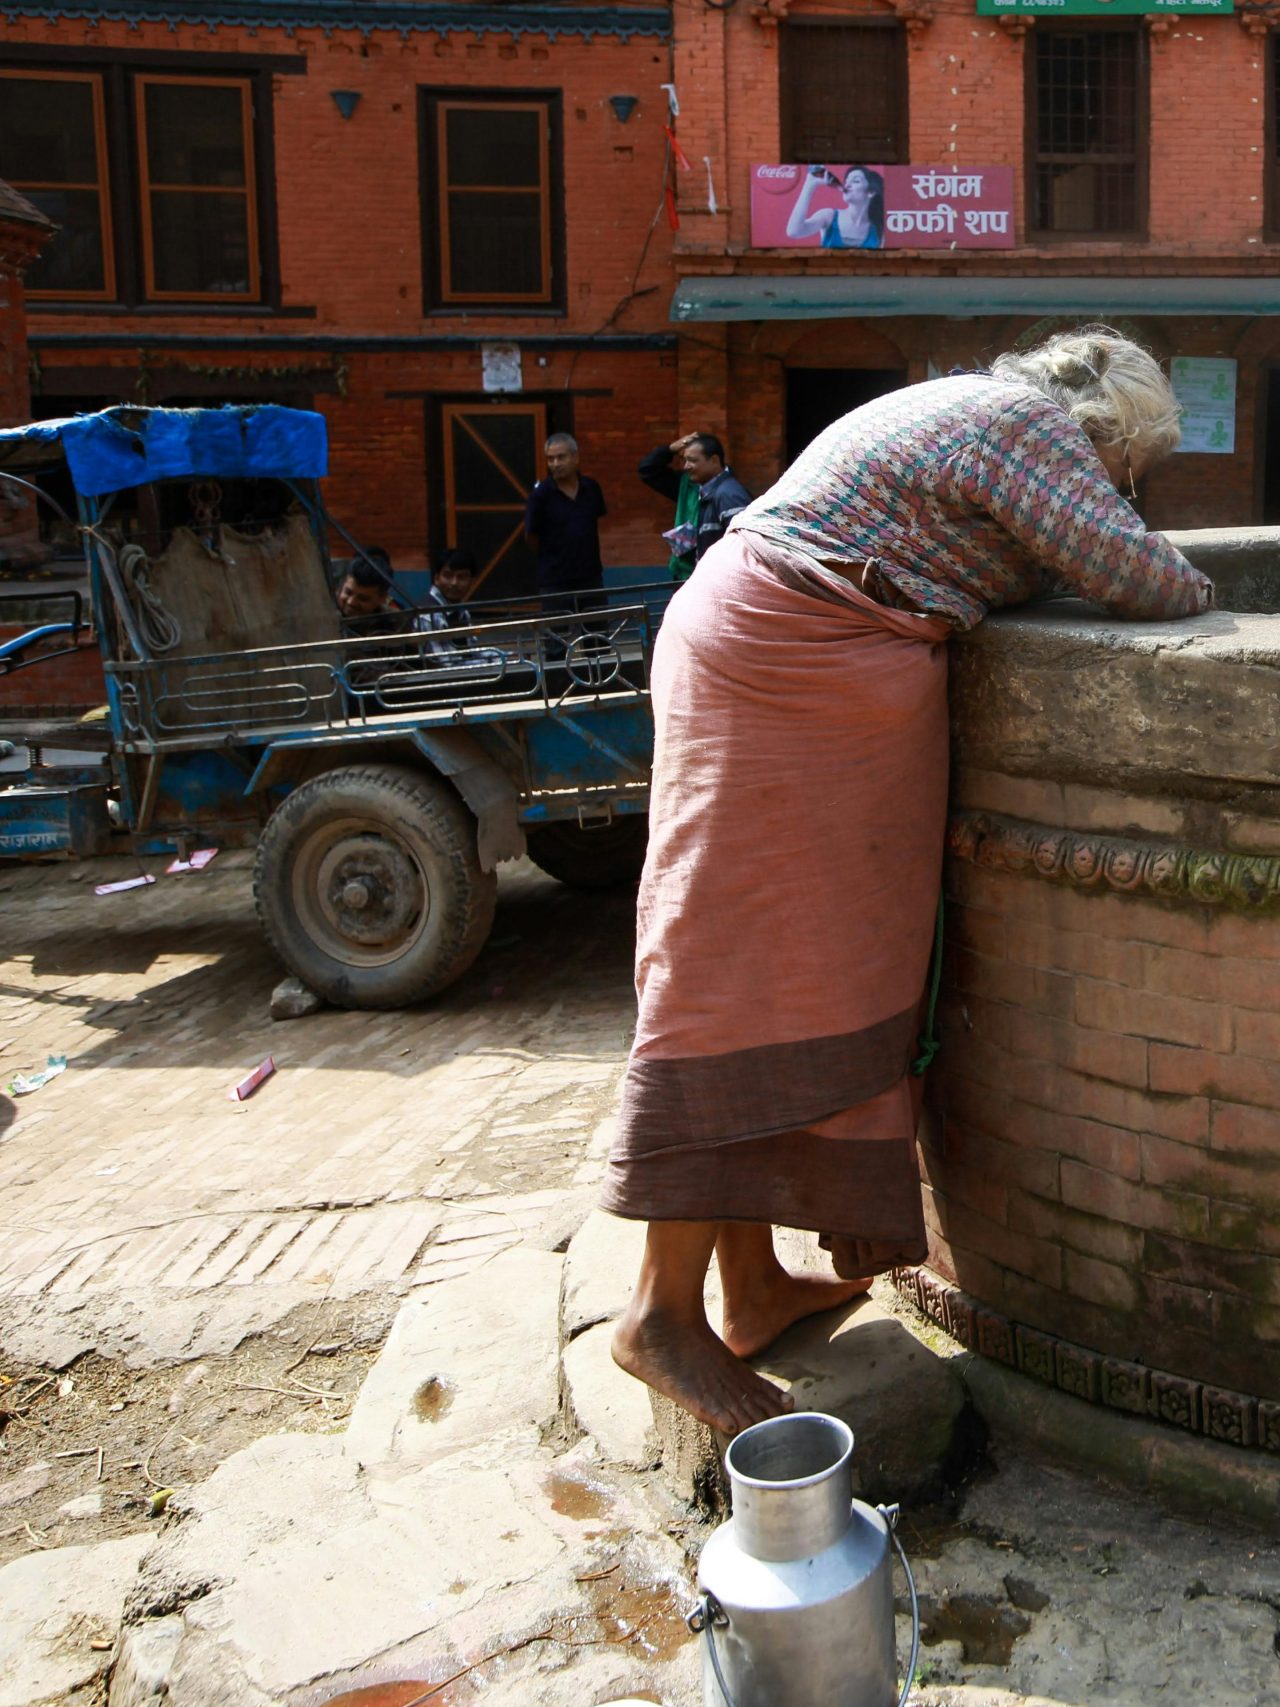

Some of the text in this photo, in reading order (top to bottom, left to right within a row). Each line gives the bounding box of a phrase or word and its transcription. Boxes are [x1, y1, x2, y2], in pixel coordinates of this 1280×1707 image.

[757, 164, 796, 178] Coca-Cola
[912, 170, 983, 199] संगम
[886, 203, 1009, 235] कफी शप
